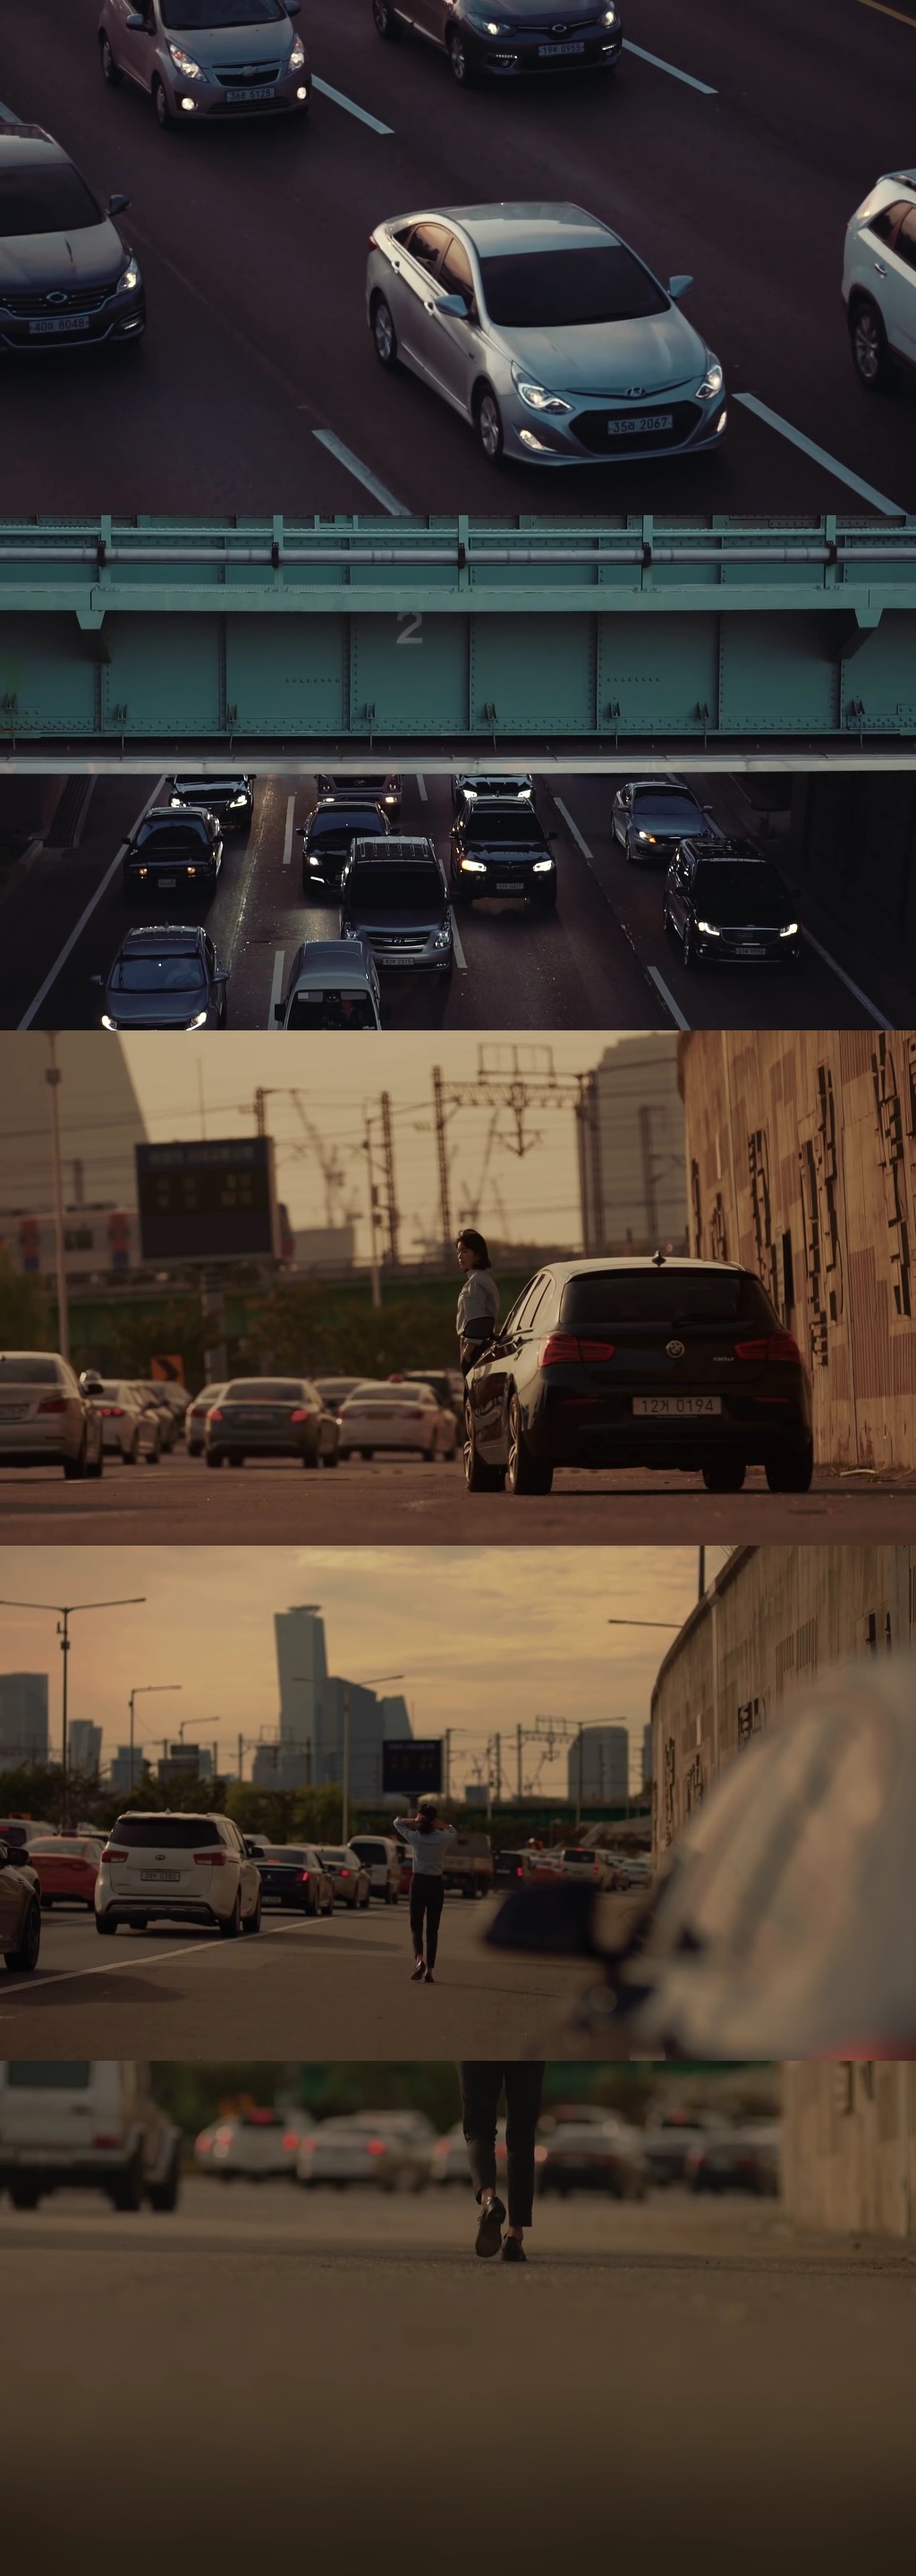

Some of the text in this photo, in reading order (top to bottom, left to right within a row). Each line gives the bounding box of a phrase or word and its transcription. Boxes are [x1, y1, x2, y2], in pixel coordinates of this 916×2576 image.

[250, 89, 271, 98] 5125
[58, 318, 85, 329] 8048
[640, 417, 667, 430] 2067
[396, 612, 423, 644] 2
[676, 1399, 714, 1413] 0194
